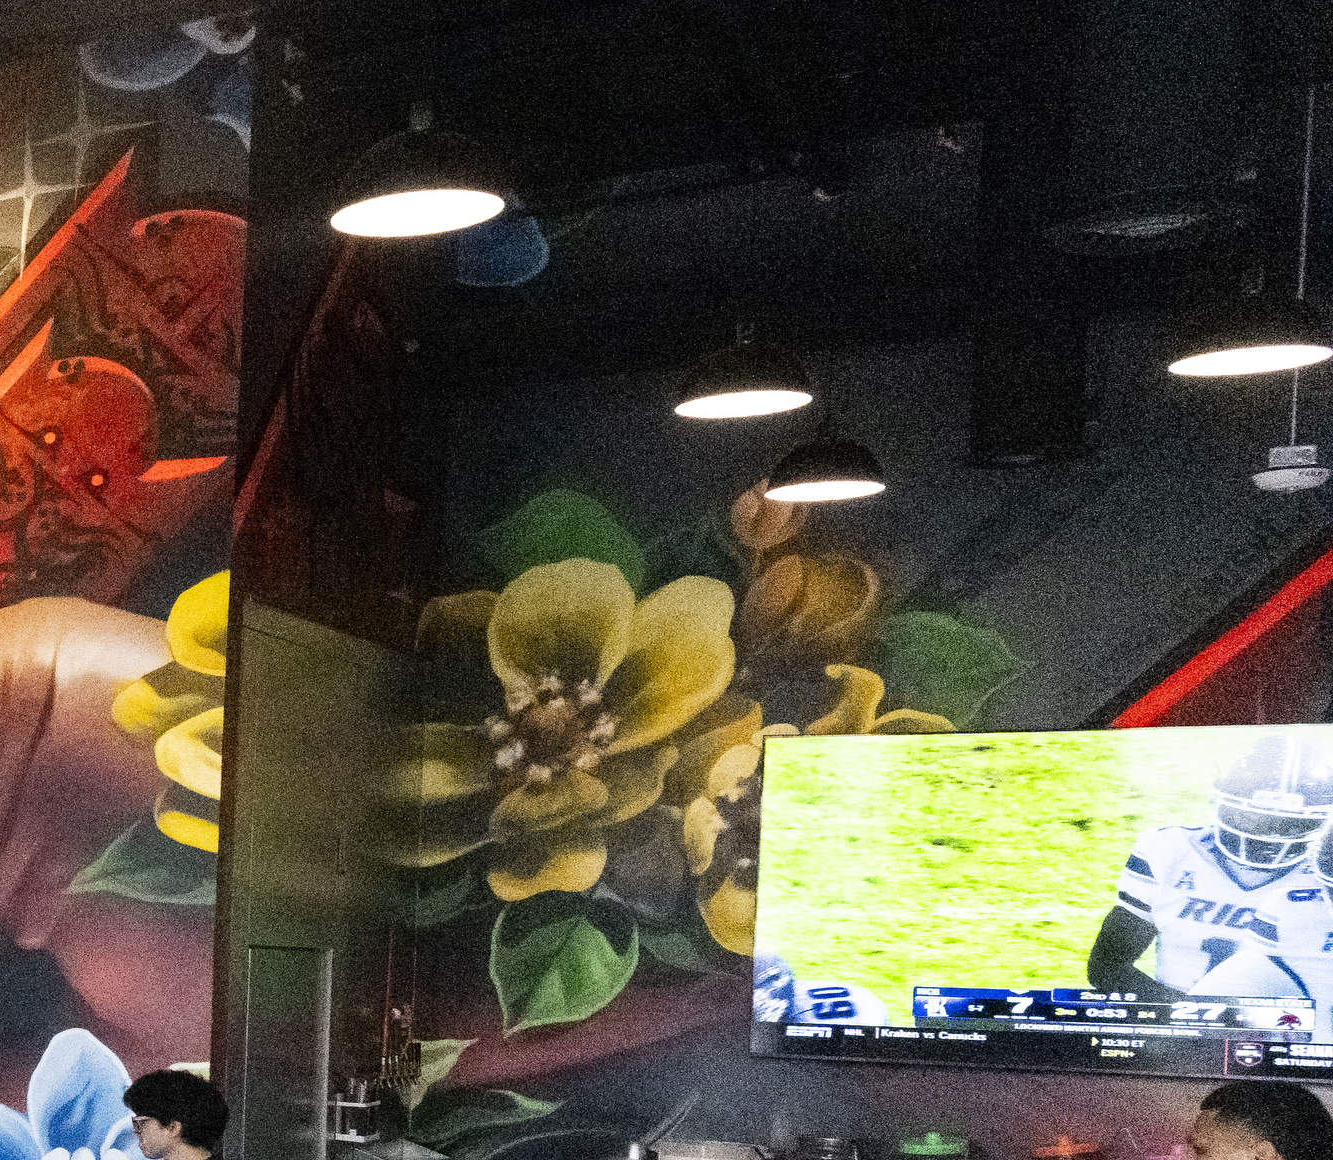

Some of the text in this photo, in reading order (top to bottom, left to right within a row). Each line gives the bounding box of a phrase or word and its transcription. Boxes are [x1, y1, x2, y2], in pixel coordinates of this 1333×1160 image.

[1006, 996, 1034, 1014] 7
[1170, 1001, 1227, 1021] 27
[1085, 1007, 1128, 1019] 0:53
[786, 1025, 832, 1038] ESPN
[880, 1028, 920, 1039] Kraken
[923, 1031, 935, 1039] vs
[938, 1031, 987, 1041] Canucks
[1101, 1038, 1146, 1048] 10:30 ET
[1100, 1049, 1136, 1058] ESPN+
